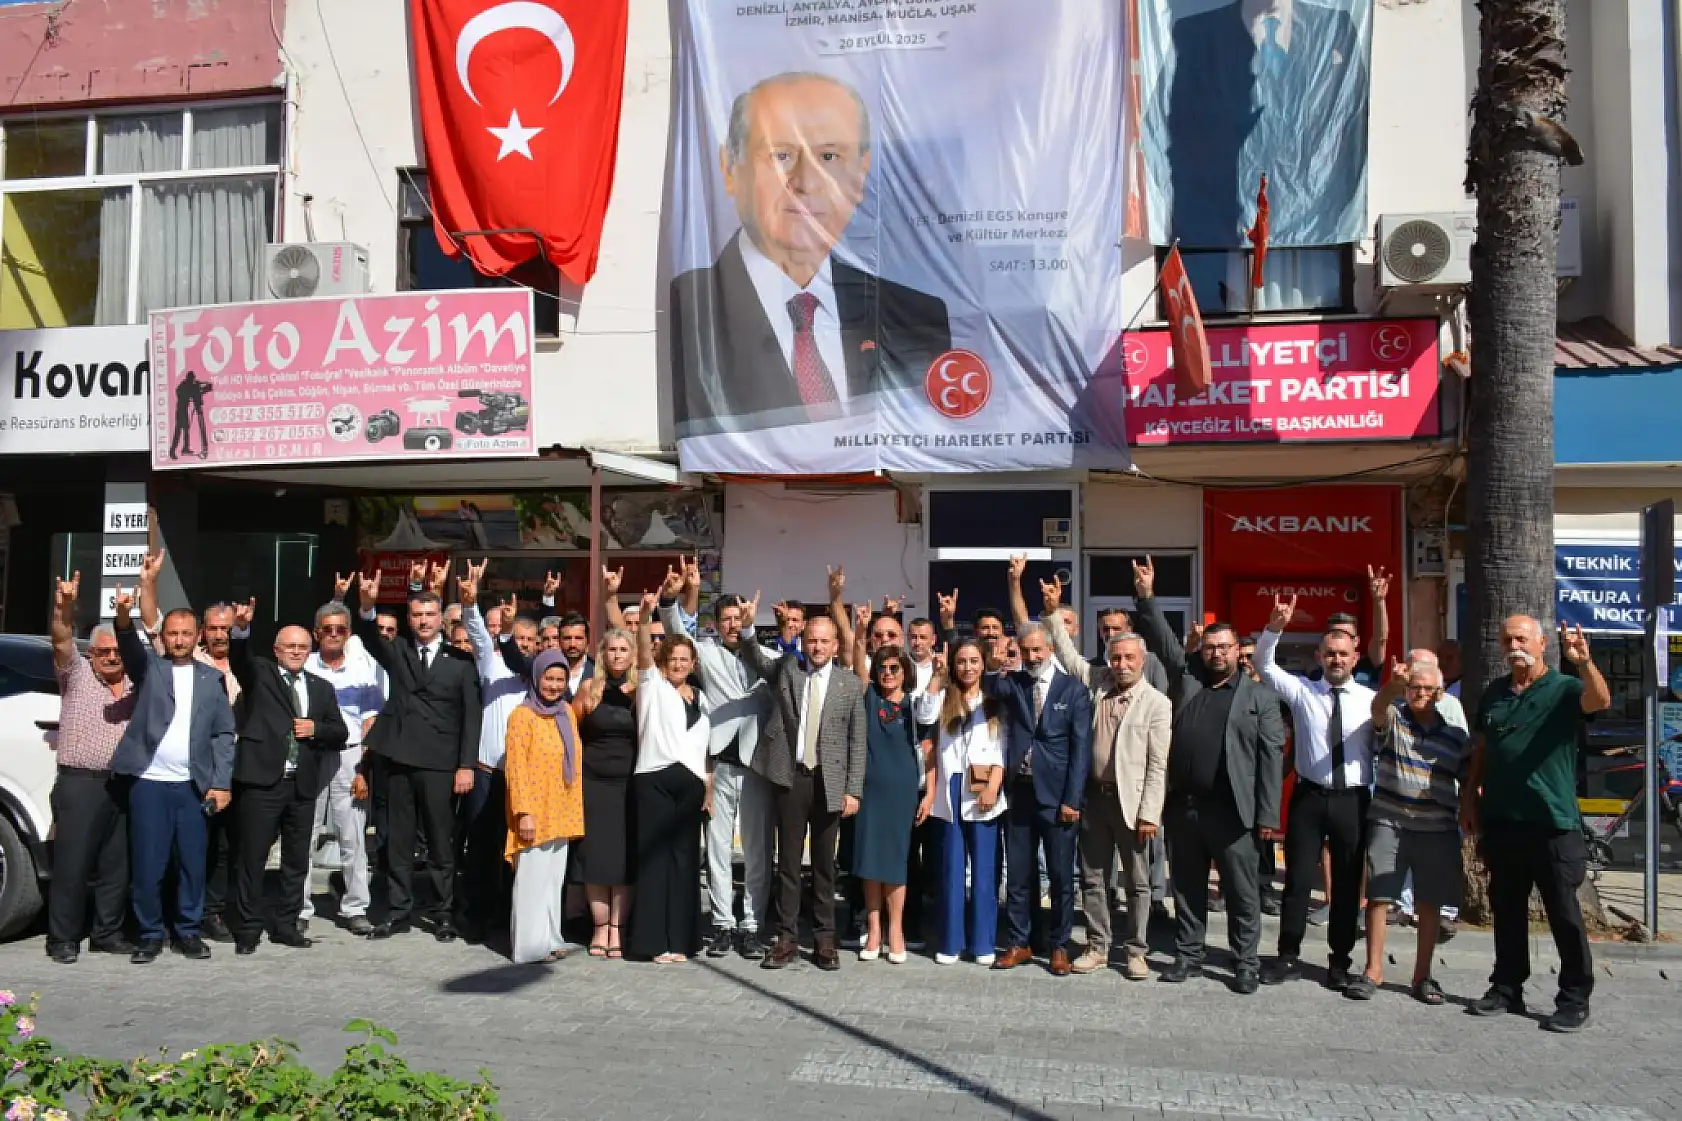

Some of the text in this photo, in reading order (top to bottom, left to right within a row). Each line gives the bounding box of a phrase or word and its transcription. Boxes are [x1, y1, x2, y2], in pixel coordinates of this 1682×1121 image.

[737, 2, 788, 16] DENİZLİ,
[785, 3, 977, 27] İZMİR, MANİSA, MUĞLA, UŞAK
[840, 31, 926, 49] 20 EYLÜL 2025
[938, 210, 983, 224] Denizli
[987, 210, 1014, 221] EGS
[1018, 210, 1068, 223] Kongre
[947, 232, 962, 243] ve
[966, 227, 1008, 241] Kültür
[1030, 258, 1068, 271] 13.00
[168, 296, 527, 376] Foto Azim
[413, 380, 435, 391] Tüm
[1280, 367, 1409, 402] PARTİSİ
[11, 415, 75, 430] Reasürans
[80, 412, 141, 431] Brokerliği
[1145, 409, 1384, 435] KÖYCEĞİZ İLÇE BAŞKANLIĞI
[934, 432, 1015, 447] HAREKET
[1231, 516, 1373, 532] AKBANK
[105, 553, 146, 568] SEYAHA
[1564, 554, 1632, 571] TEKNİK
[1256, 586, 1337, 597] AKBANK
[1559, 589, 1631, 604] FATURA
